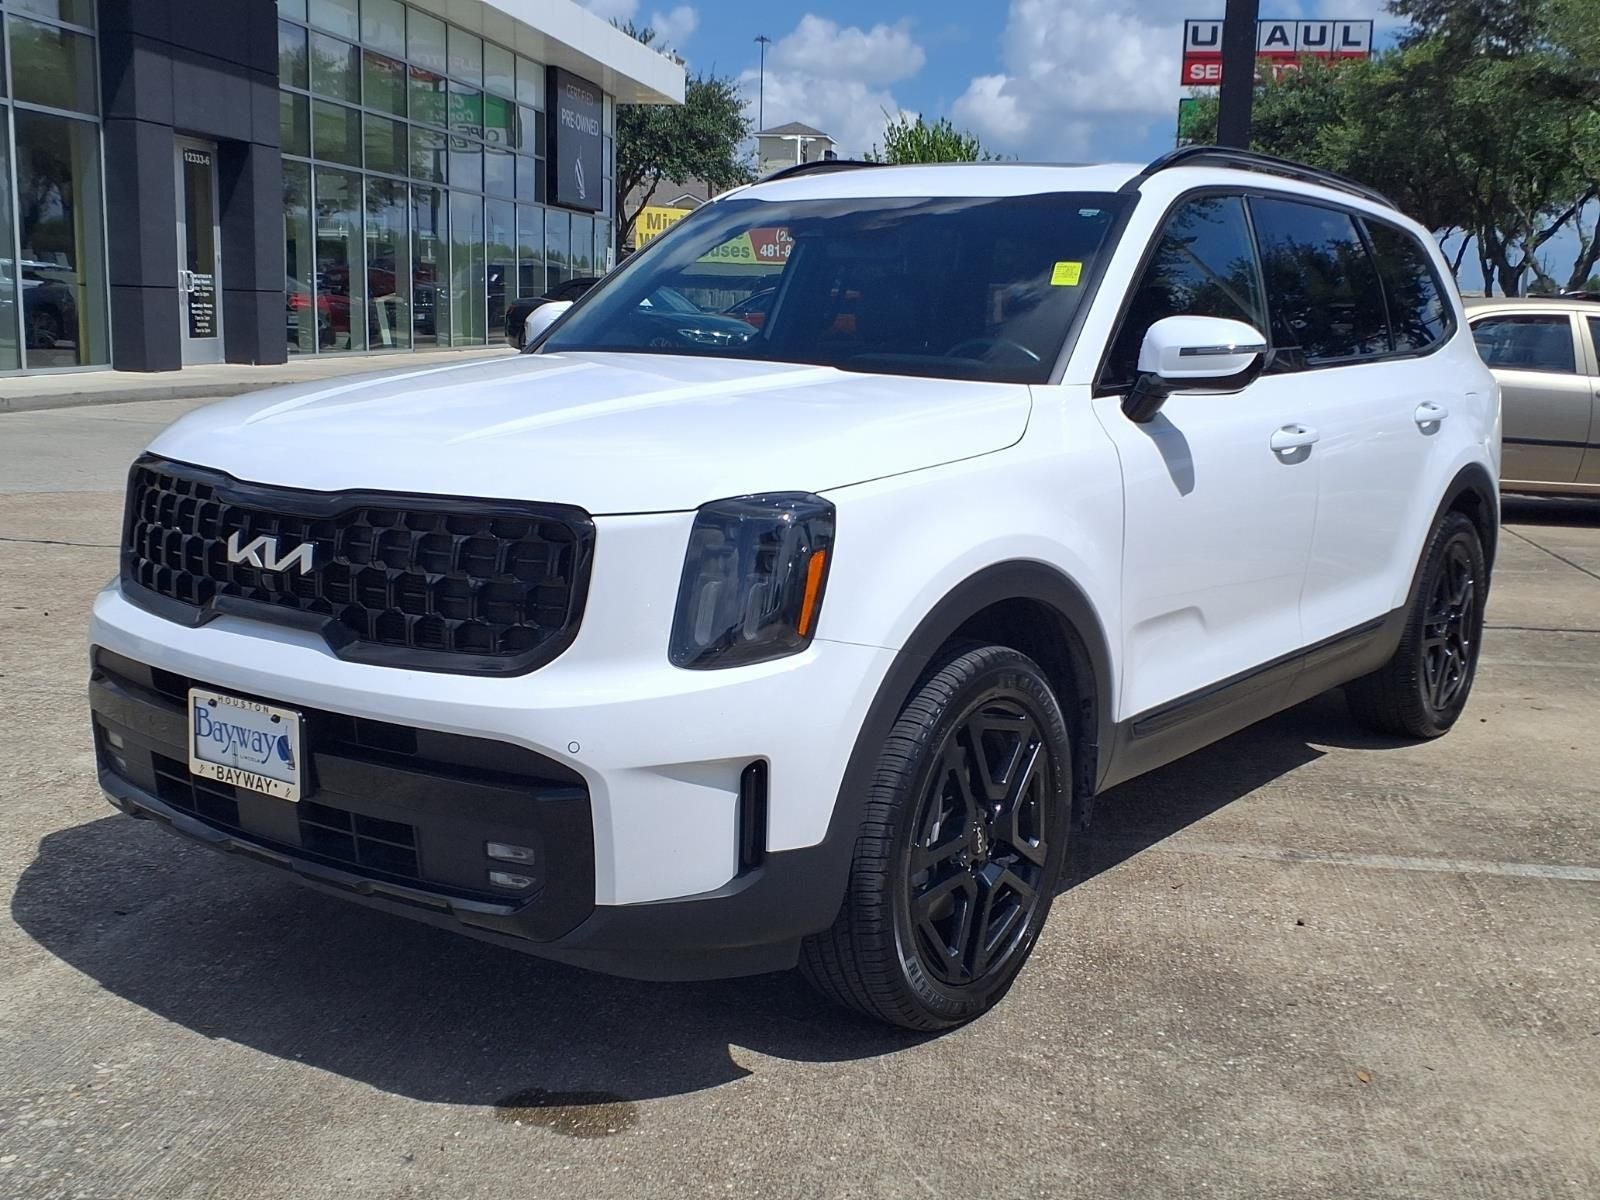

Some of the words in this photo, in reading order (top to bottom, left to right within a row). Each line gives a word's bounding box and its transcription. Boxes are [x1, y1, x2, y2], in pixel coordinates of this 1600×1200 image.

[1191, 25, 1361, 47] UAUL
[1190, 64, 1222, 79] SE
[561, 108, 599, 136] PRE-OWNED
[184, 152, 210, 165] 12333-6
[227, 530, 314, 576] KIA
[217, 696, 269, 714] HOUSTON
[194, 705, 277, 764] Bayway
[216, 766, 272, 793] BAYWAY
